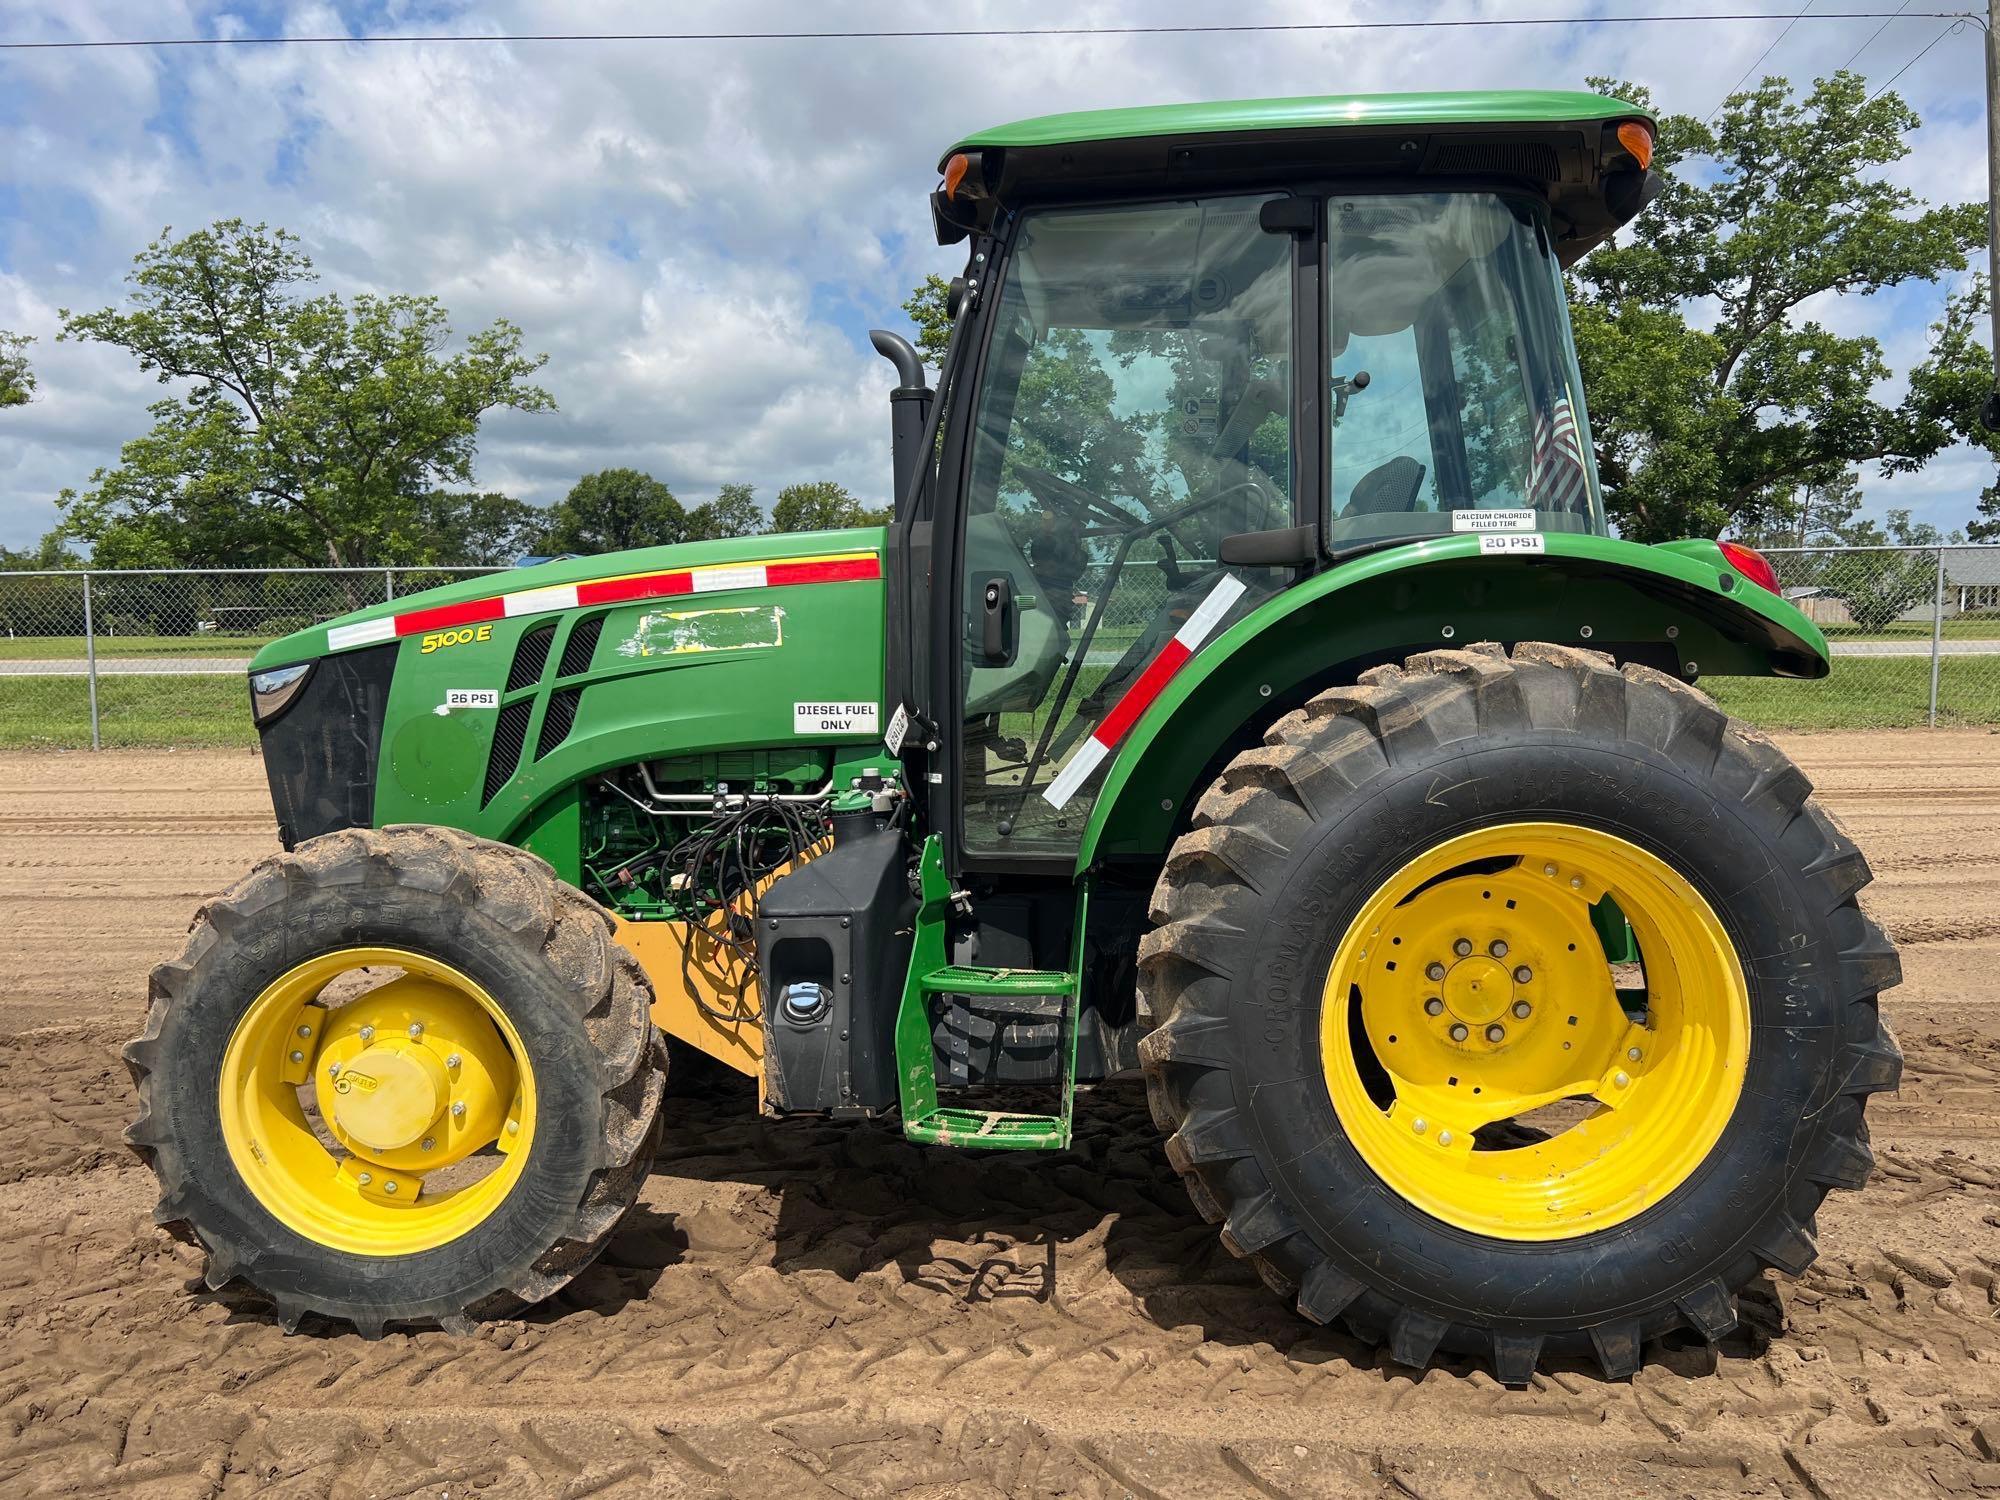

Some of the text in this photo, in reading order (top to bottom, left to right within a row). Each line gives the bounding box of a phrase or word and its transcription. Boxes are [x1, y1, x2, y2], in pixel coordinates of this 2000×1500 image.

[1493, 512, 1533, 520] CHLORIDE
[1499, 520, 1518, 528] TIRE
[1486, 537, 1539, 548] 20 PSI
[451, 694, 494, 704] 26 PSI
[797, 705, 875, 715] DIESEL FUEL
[821, 720, 852, 730] ONLY
